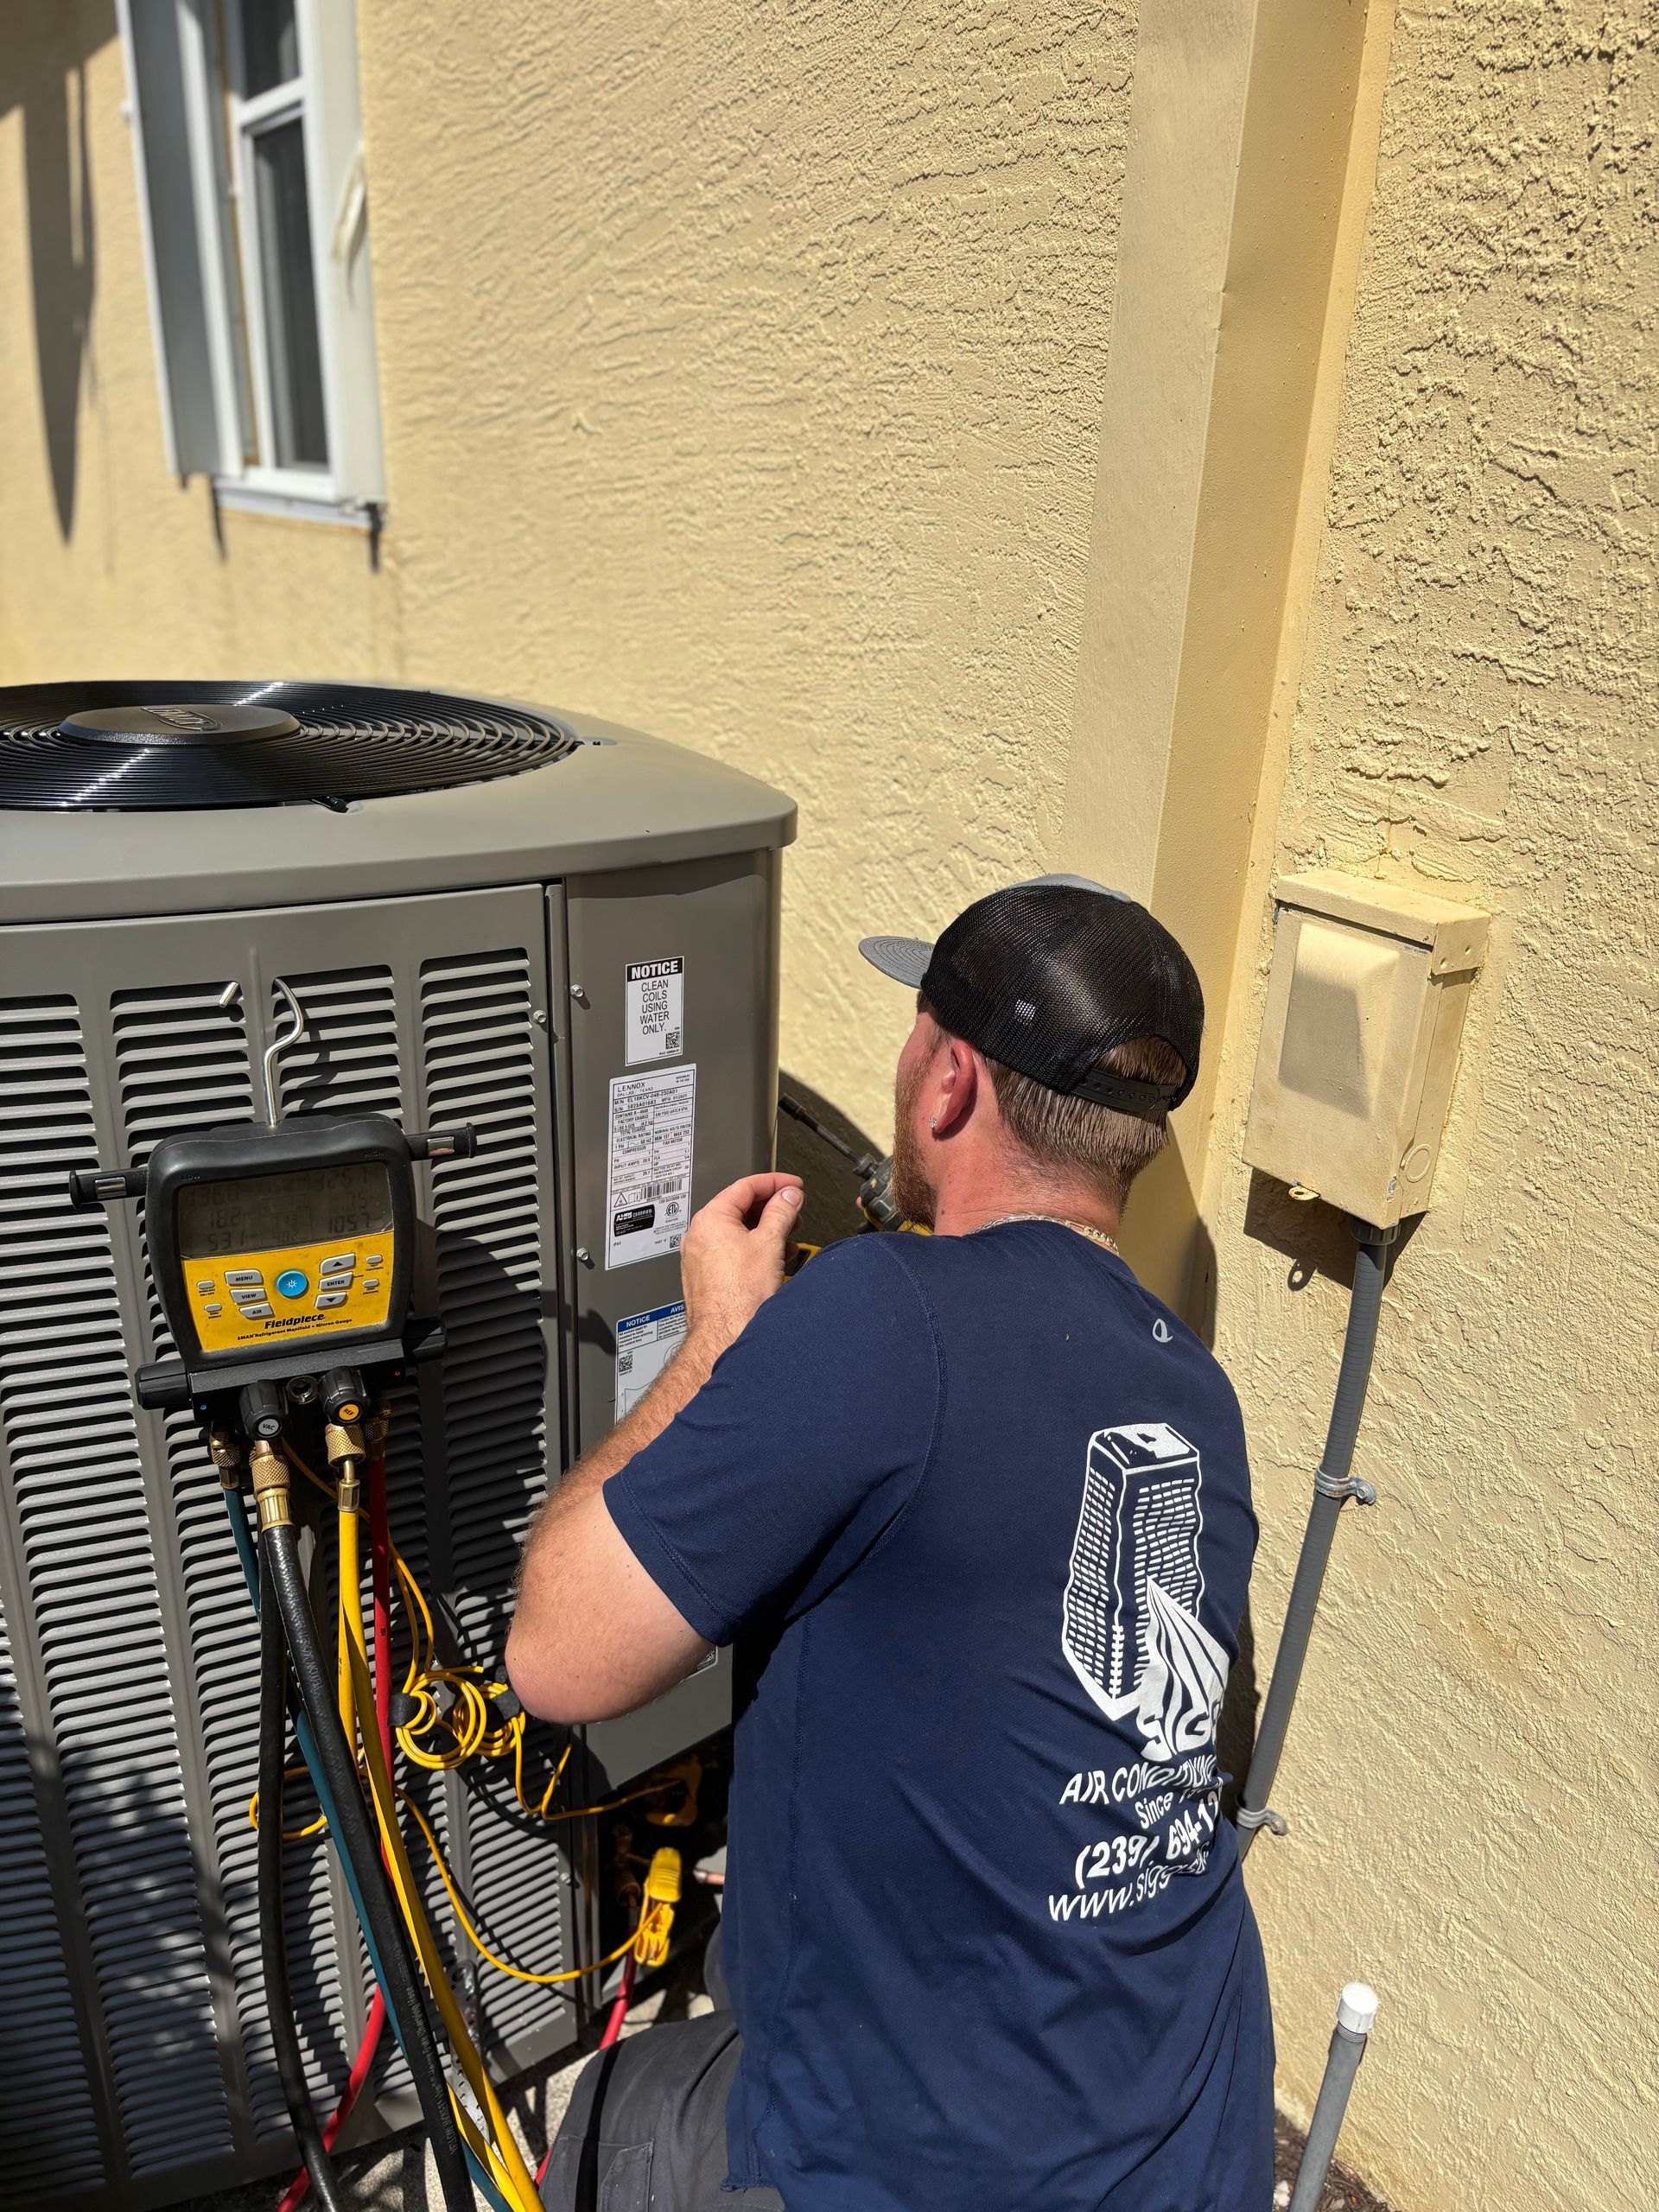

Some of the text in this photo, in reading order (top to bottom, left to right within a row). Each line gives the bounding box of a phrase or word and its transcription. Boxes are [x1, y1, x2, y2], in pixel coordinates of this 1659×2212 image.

[632, 960, 678, 979] NOTICE
[641, 979, 669, 992] CLEAN
[642, 990, 667, 1002] COILS
[642, 1001, 668, 1014] USING
[640, 1011, 670, 1025] WATER
[642, 1022, 667, 1035] ONLY.
[618, 1082, 645, 1092] LENNOX
[671, 1304, 684, 1314] AVIS
[264, 1313, 324, 1329] Fieldpiece
[626, 1314, 651, 1328] NOTICE
[254, 1329, 286, 1338] Refrigerant
[286, 1325, 311, 1333] Manifold
[343, 1408, 354, 1416] REF
[1059, 1770, 1109, 1804] AIR
[1135, 1791, 1174, 1829] Since
[406, 1986, 416, 2005] Hose
